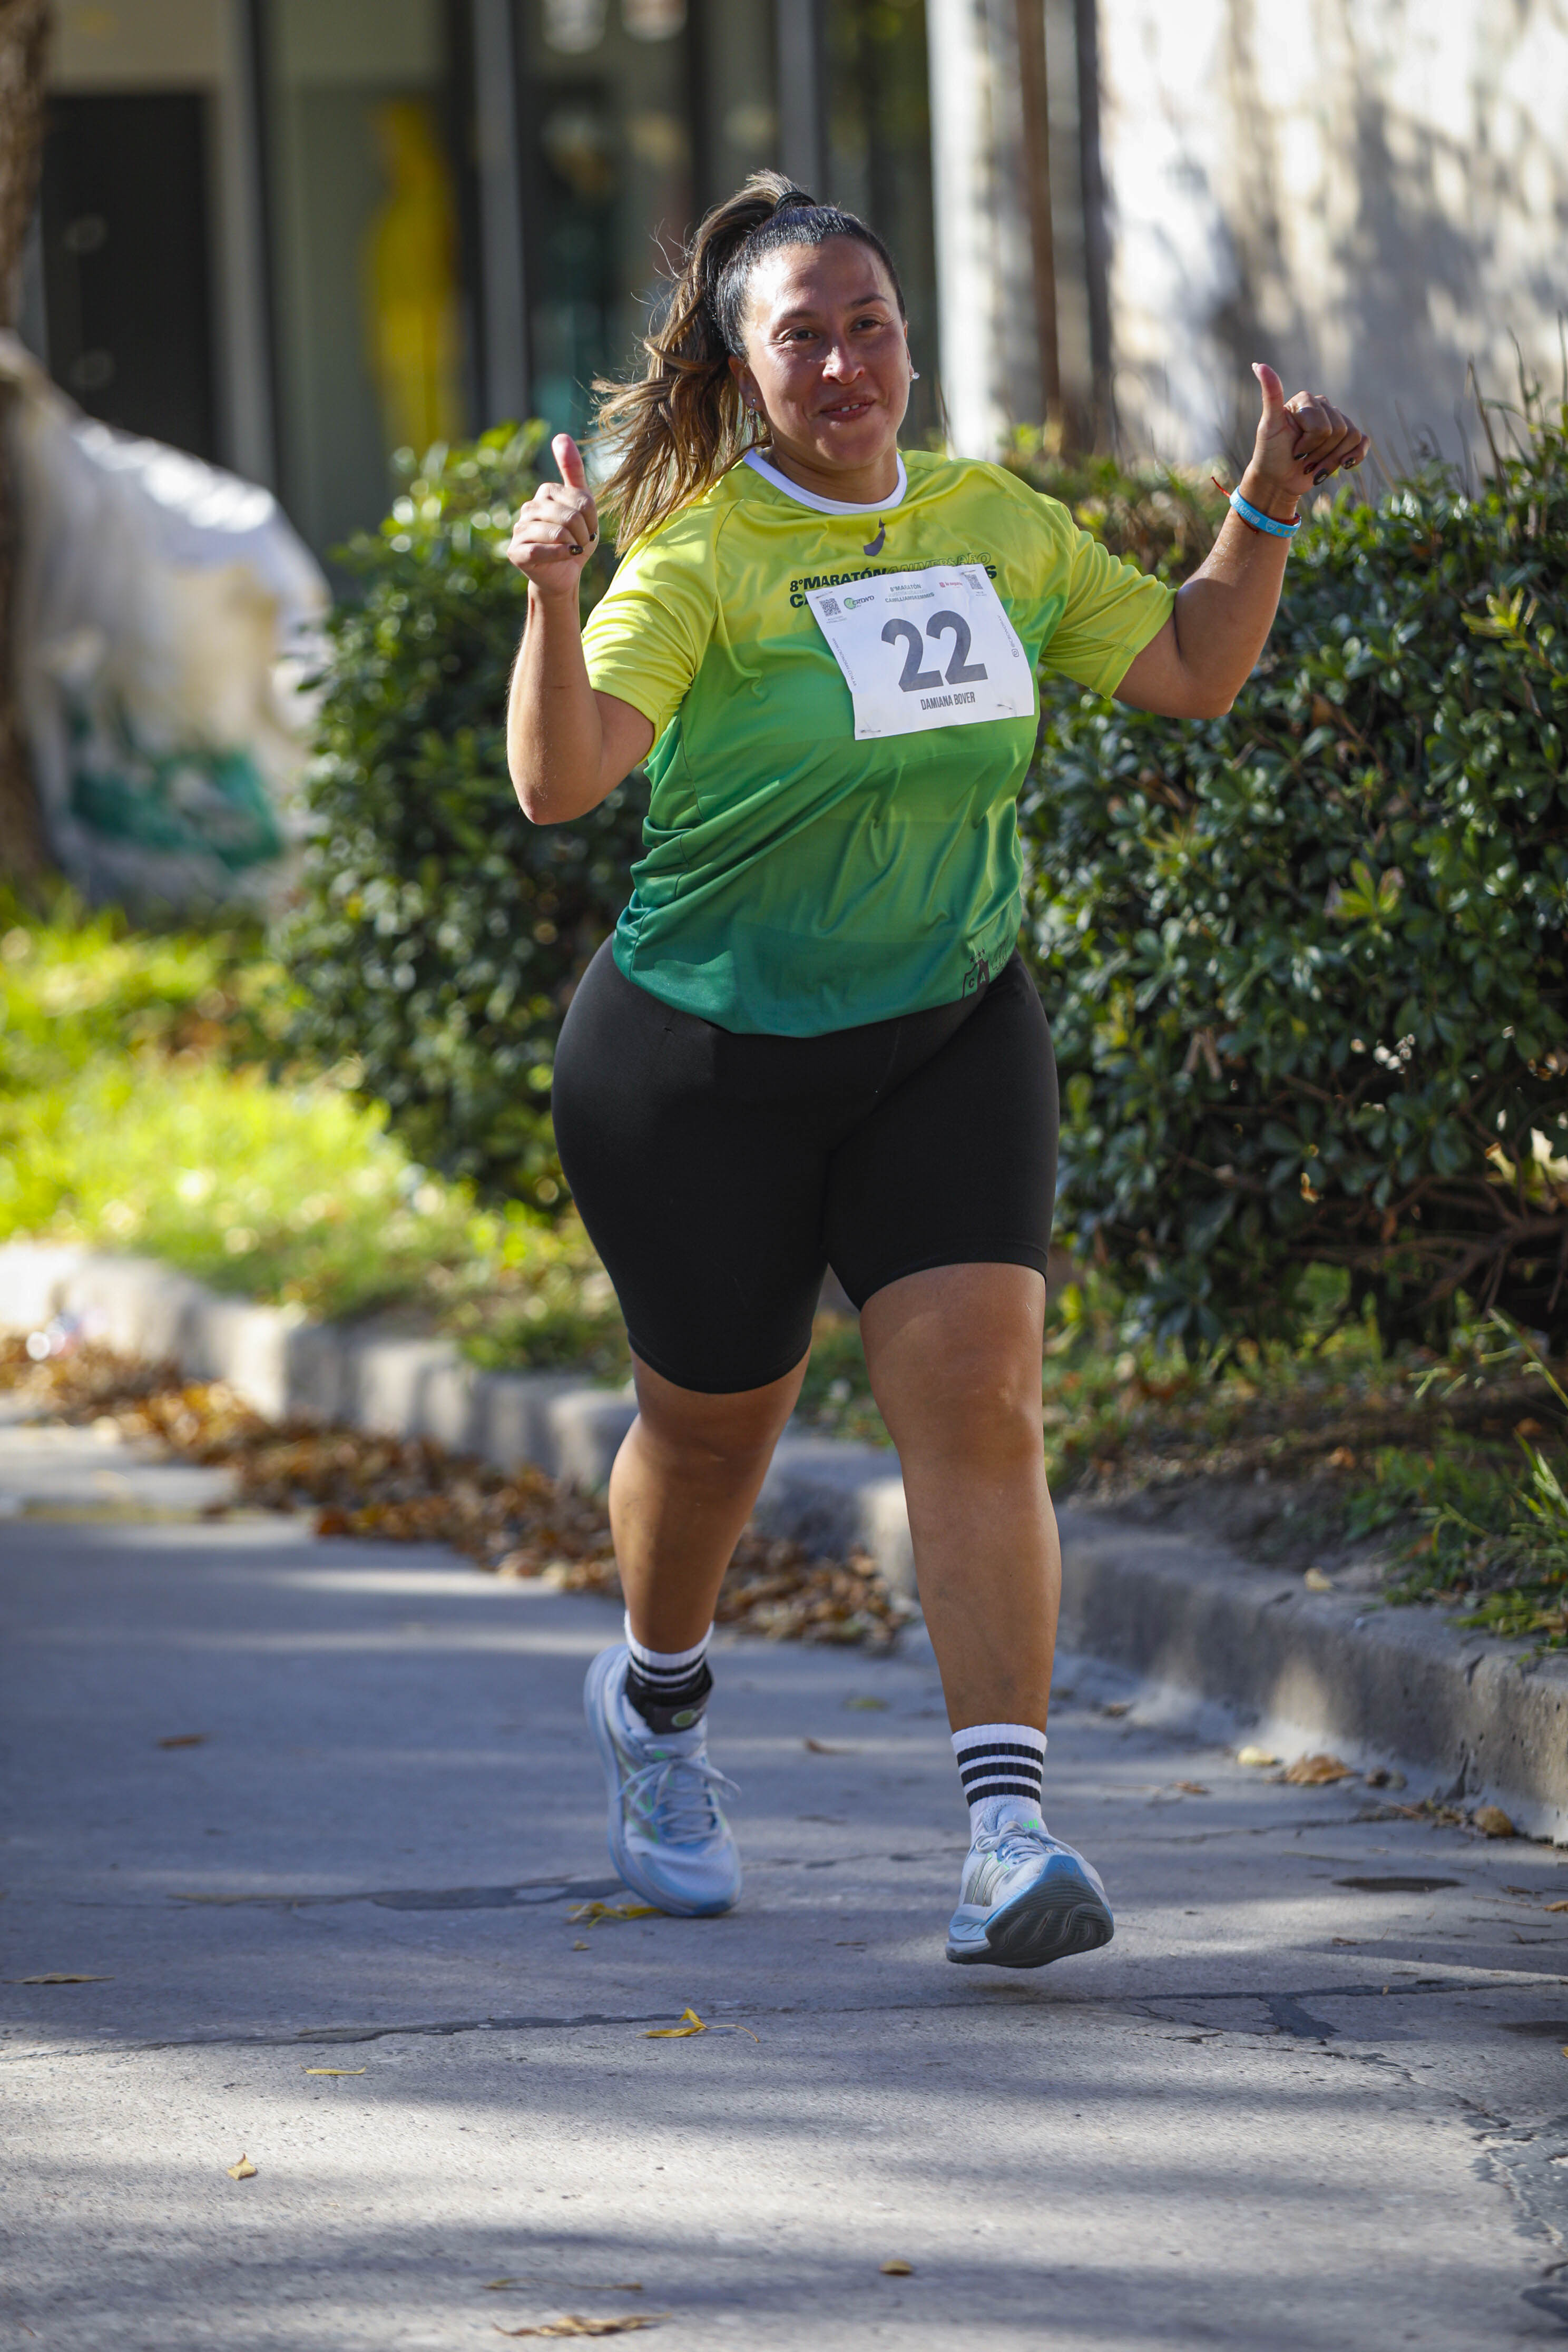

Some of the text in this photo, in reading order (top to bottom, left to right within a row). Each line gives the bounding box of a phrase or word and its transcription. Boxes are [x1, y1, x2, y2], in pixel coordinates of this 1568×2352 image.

[881, 610, 988, 692] 22
[920, 691, 976, 710] DAMIANA BOVER
